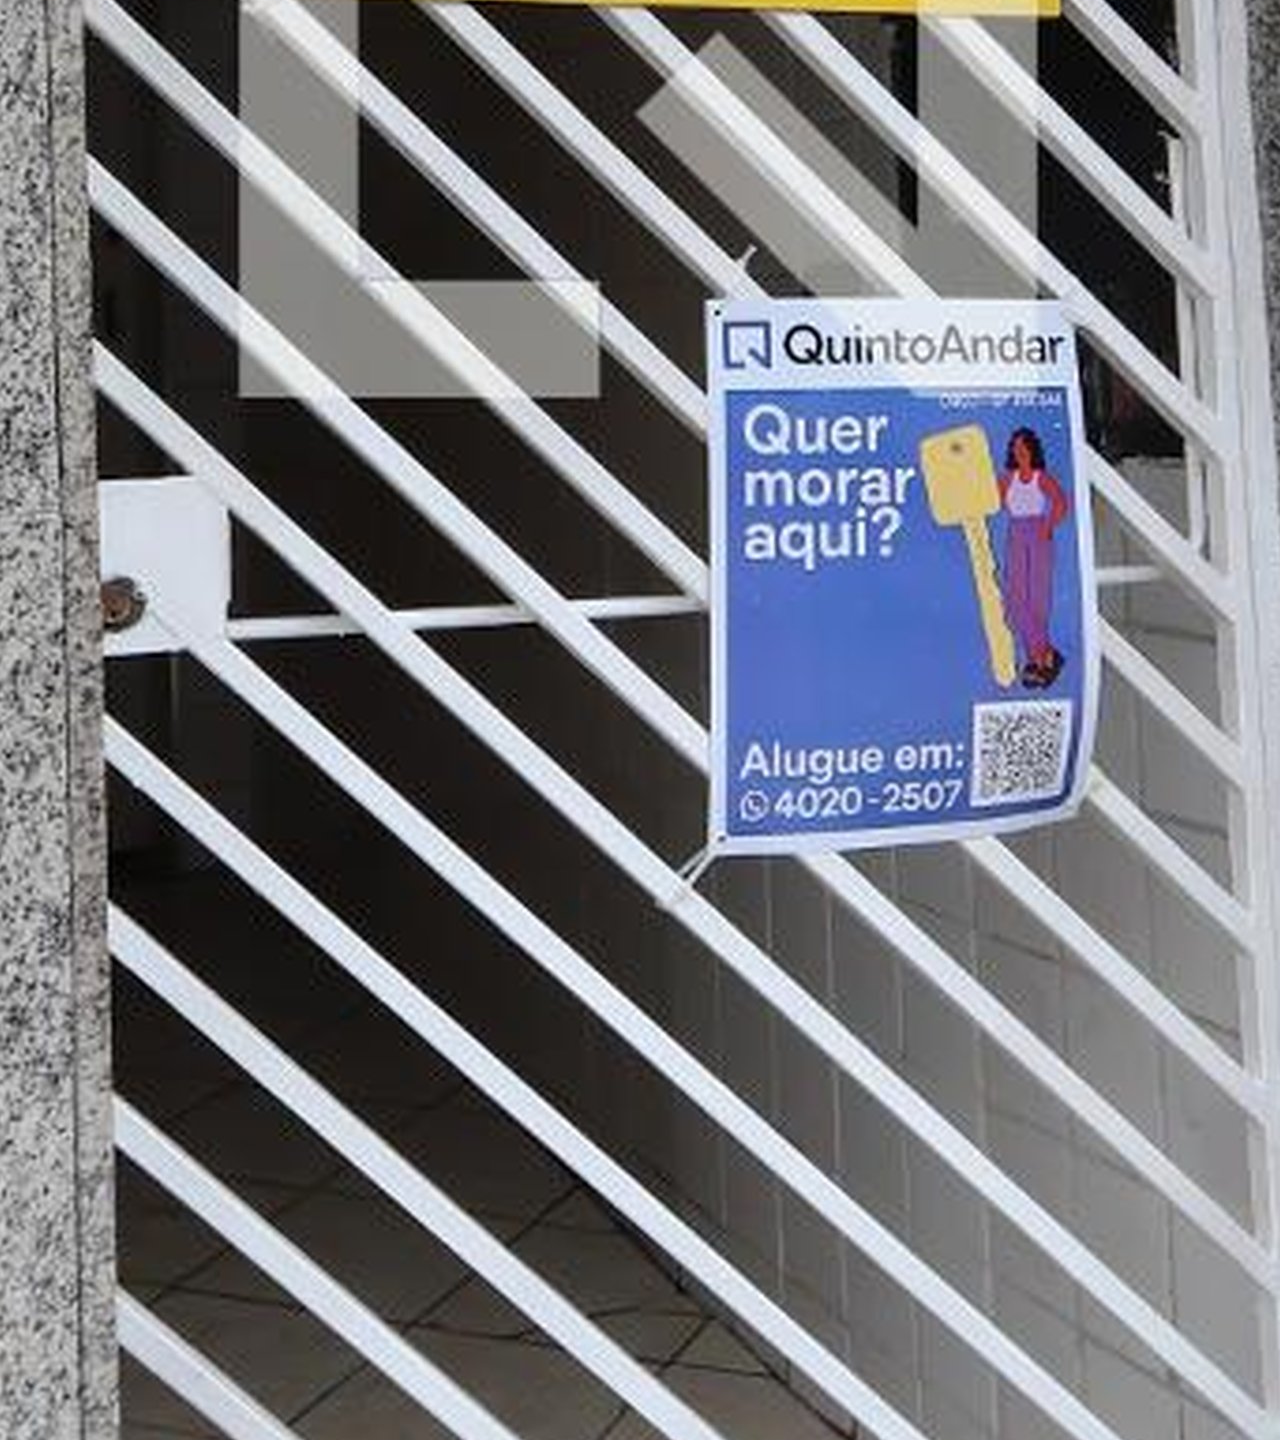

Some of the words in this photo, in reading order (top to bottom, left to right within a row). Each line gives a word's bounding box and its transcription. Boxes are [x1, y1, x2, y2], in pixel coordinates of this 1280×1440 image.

[783, 324, 1066, 365] QuintoAndar
[743, 404, 889, 455] Quer
[743, 464, 916, 508] morar
[743, 507, 902, 570] aqui?
[740, 740, 885, 784] Alugue
[894, 742, 965, 770] em:
